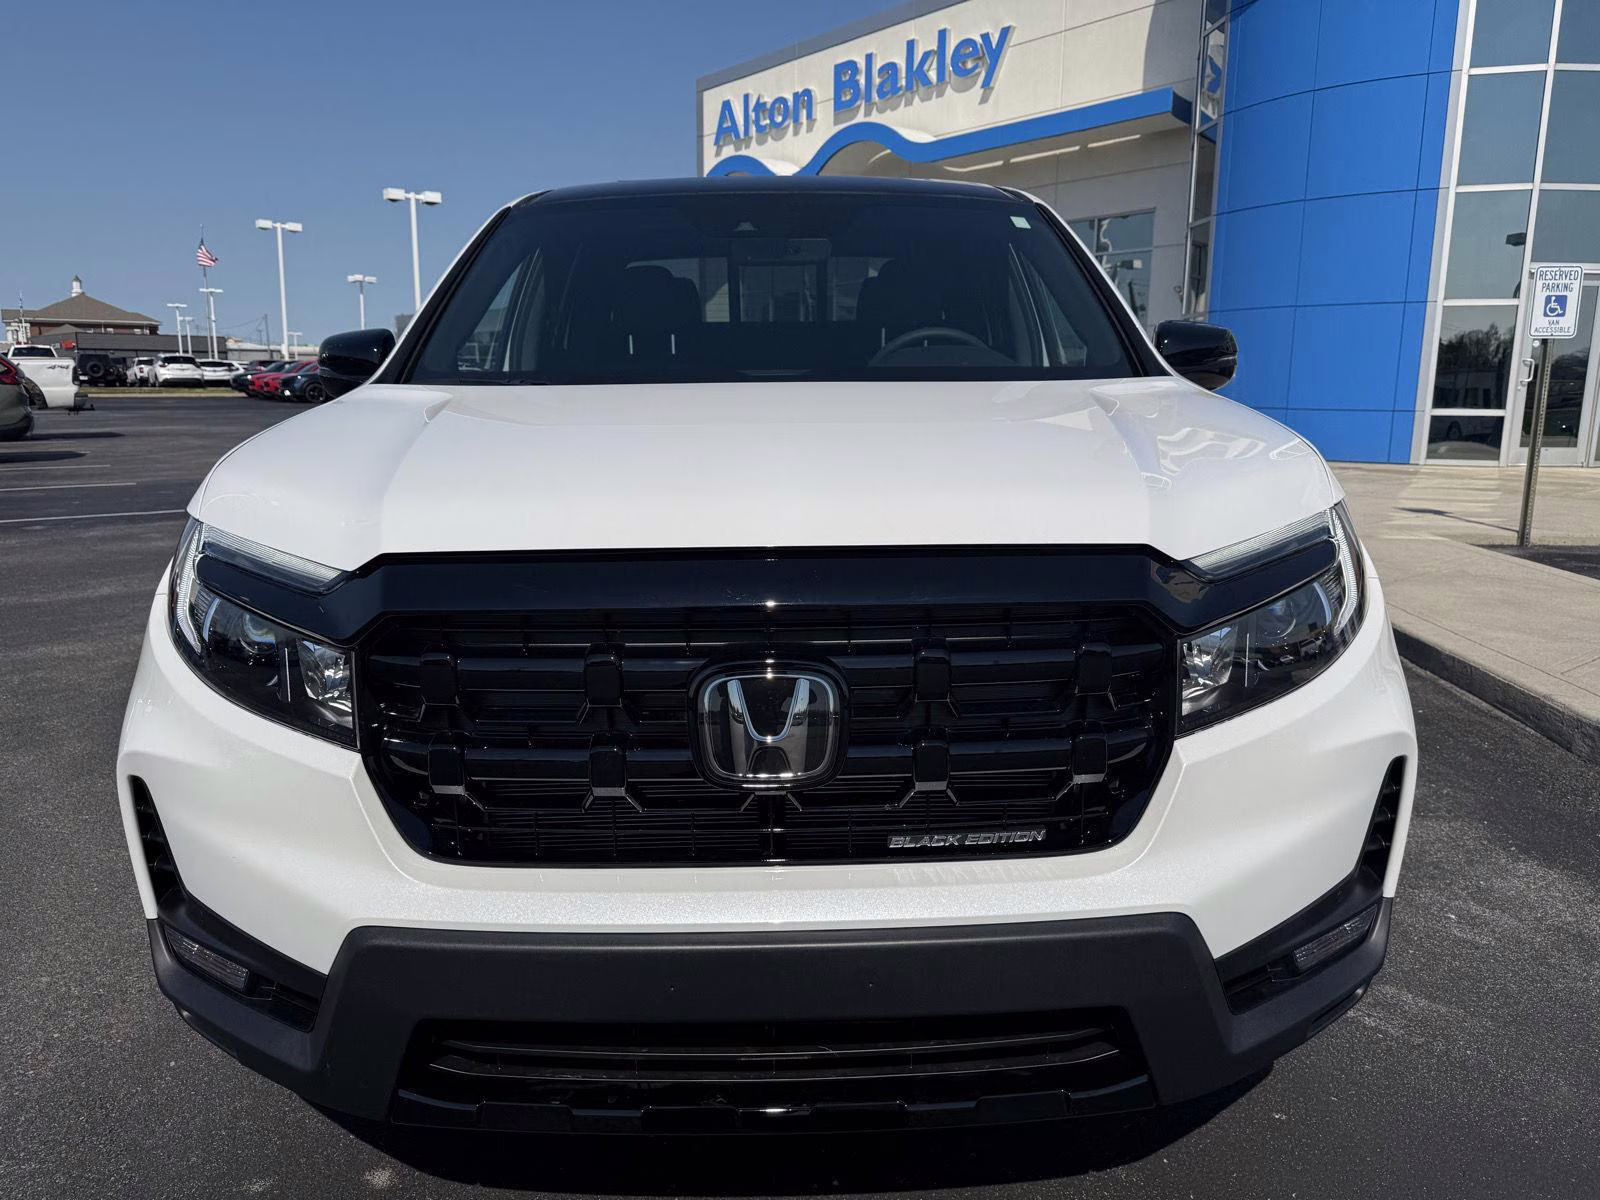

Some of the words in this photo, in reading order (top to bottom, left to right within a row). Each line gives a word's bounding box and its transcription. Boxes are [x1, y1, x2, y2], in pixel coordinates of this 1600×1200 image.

[714, 88, 814, 146] Alton
[833, 25, 1012, 113] Blakley
[1538, 269, 1580, 281] RESERVED
[1541, 282, 1574, 293] PARKING
[1533, 326, 1571, 334] ACCESSIBLE
[888, 834, 962, 848] BLACK
[964, 828, 1047, 845] EDITION
